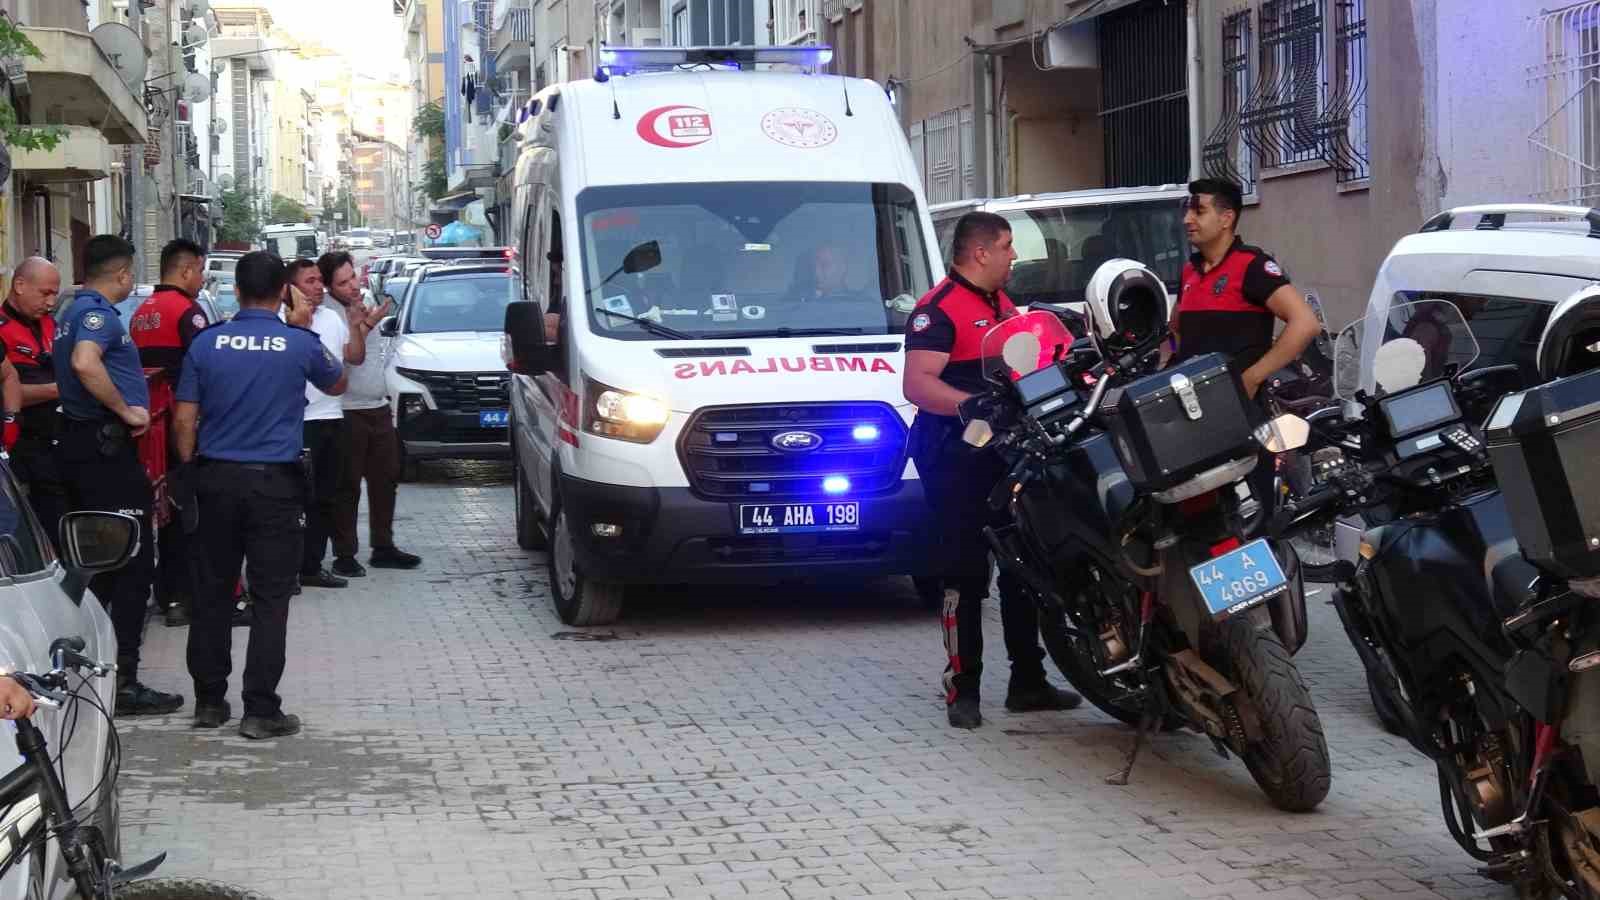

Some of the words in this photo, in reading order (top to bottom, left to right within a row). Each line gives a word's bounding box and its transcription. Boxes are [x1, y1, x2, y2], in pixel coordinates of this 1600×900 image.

[674, 116, 705, 128] 112
[483, 412, 500, 422] 44
[752, 506, 774, 526] 44
[783, 505, 815, 526] AHA
[826, 504, 856, 524] 198
[1200, 564, 1224, 585] 44
[1241, 551, 1256, 570] A
[1221, 570, 1269, 602] 4869
